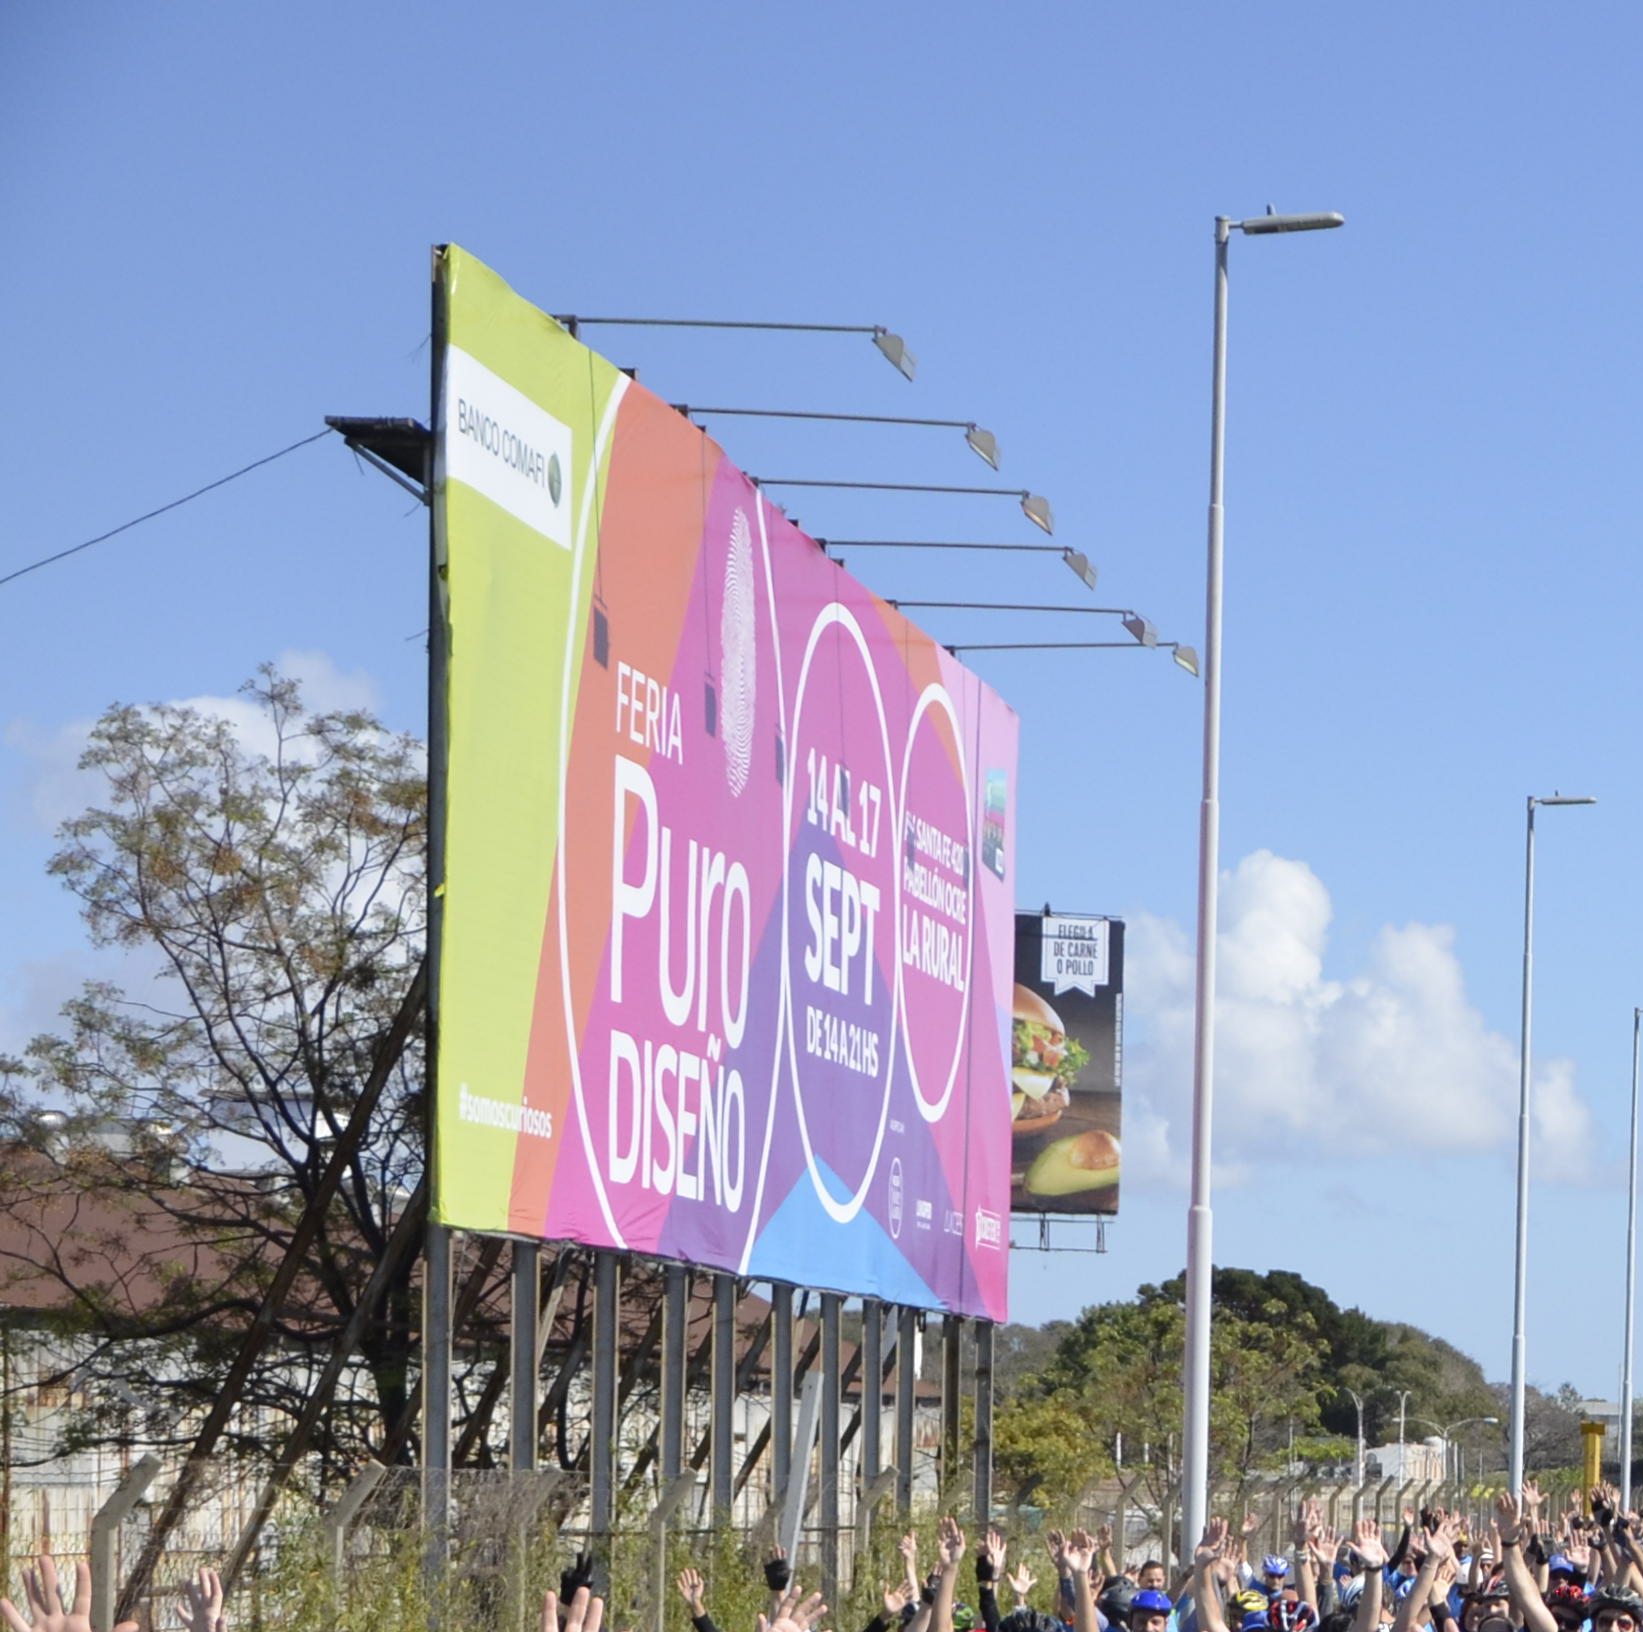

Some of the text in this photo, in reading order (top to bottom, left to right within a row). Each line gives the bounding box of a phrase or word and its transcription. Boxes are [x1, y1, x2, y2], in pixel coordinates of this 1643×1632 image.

[458, 397, 546, 489] BANCO COMAFI
[616, 660, 683, 766] FERIA
[806, 746, 882, 859] 14 AL 17
[610, 753, 751, 1050] Puro
[804, 852, 881, 1007] SEPT
[903, 903, 965, 994] LA RURAL
[1053, 941, 1098, 960] DE CARNE
[1056, 959, 1094, 976] O POLLO
[806, 1005, 822, 1056] DE
[823, 1012, 838, 1062] 14
[849, 1023, 862, 1071] 21
[862, 1028, 879, 1079] HS
[609, 1028, 745, 1214] DISEÑO
